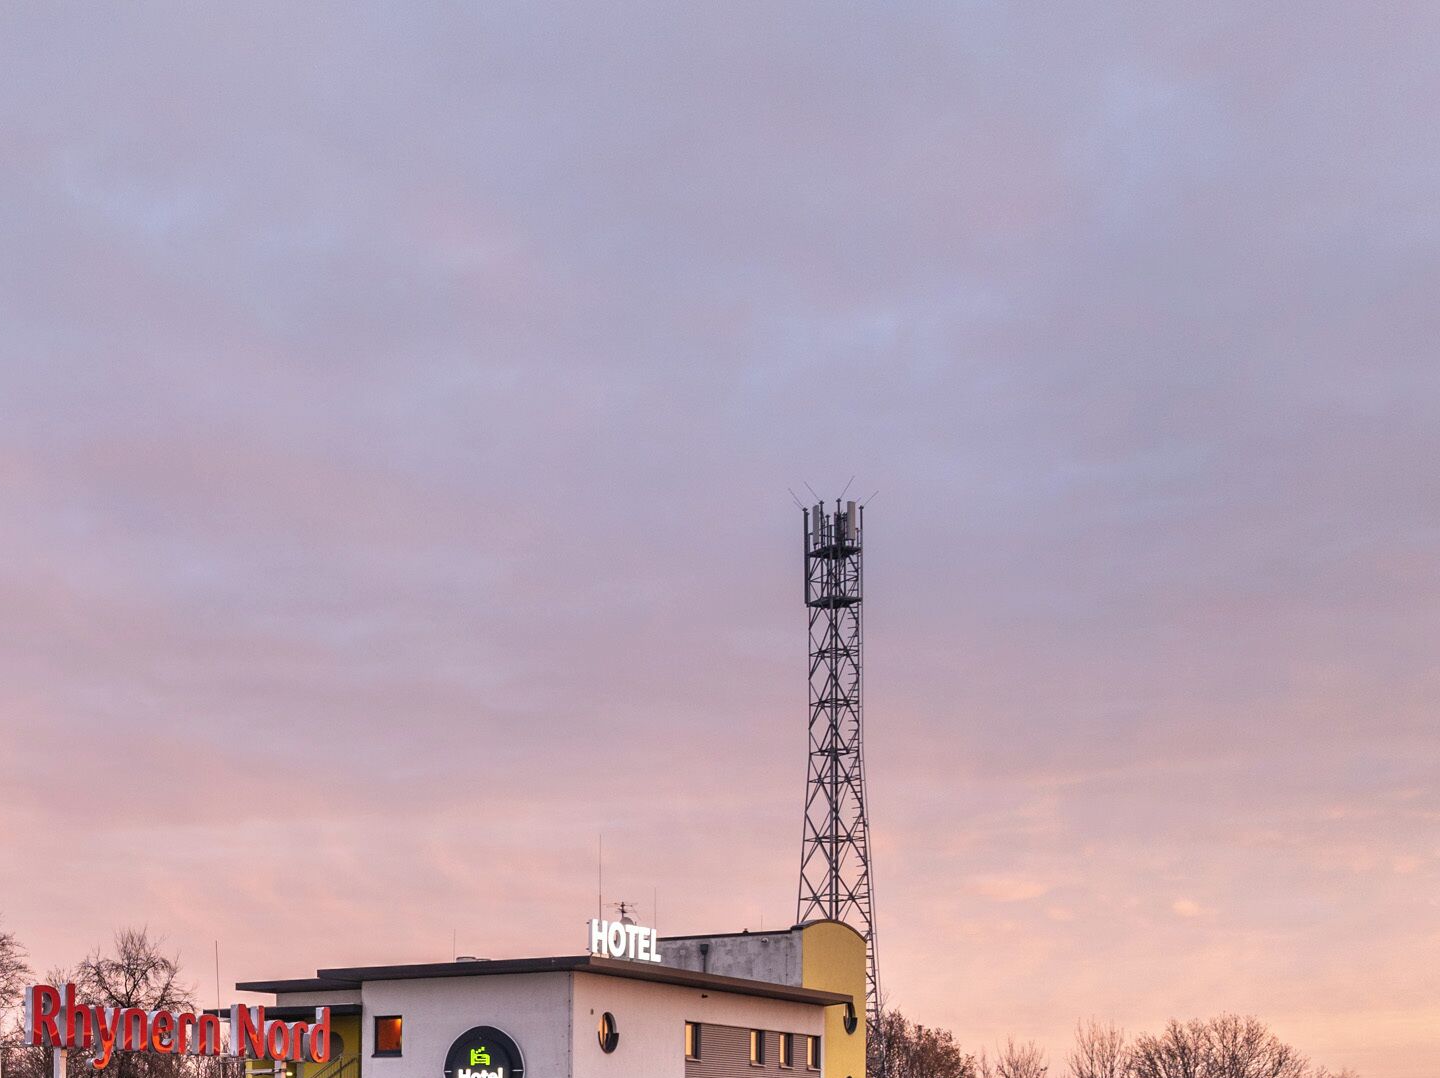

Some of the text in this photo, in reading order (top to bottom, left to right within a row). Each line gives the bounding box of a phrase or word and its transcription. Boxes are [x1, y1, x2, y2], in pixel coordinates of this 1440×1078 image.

[591, 918, 661, 962] HOTEL
[28, 983, 330, 1069] Rhynern Nord
